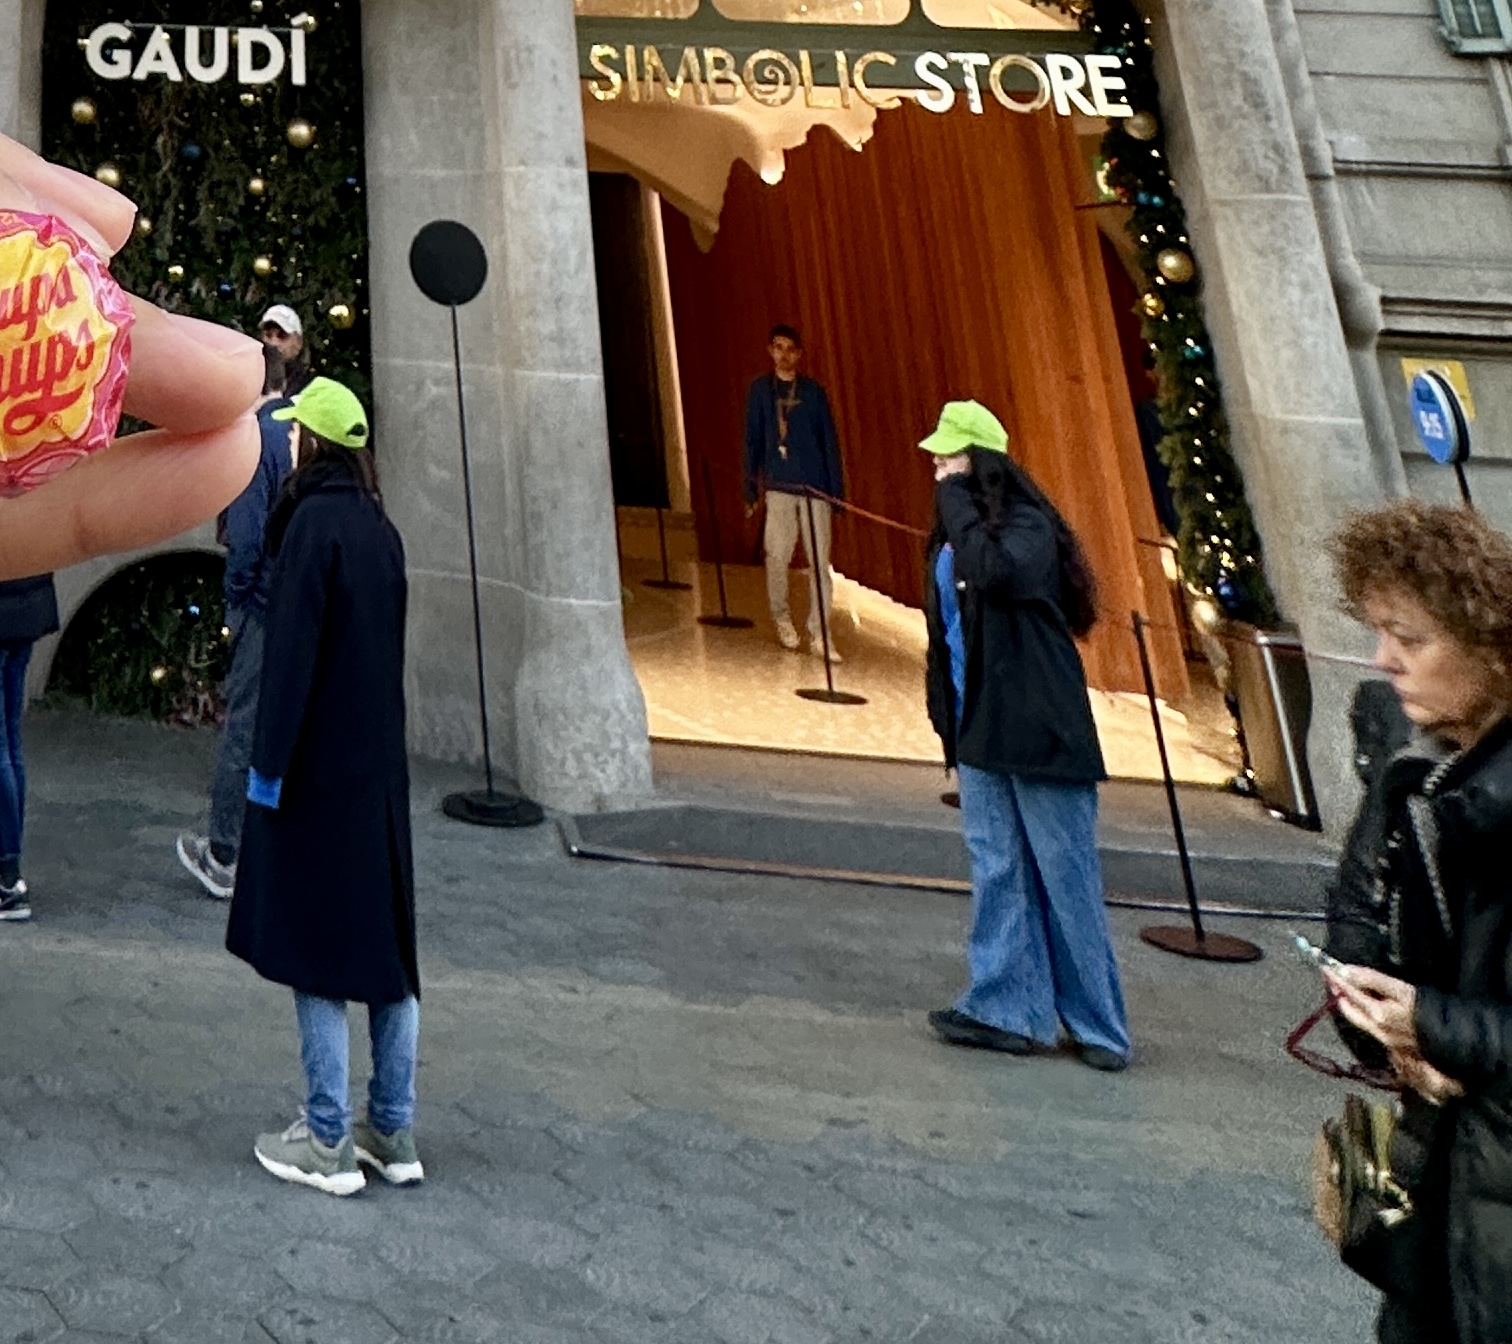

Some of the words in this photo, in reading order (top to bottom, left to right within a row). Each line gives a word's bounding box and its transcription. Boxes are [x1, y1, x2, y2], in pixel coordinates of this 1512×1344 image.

[85, 12, 307, 87] GAUDÍ
[588, 44, 903, 110] SIMBOLIC
[914, 51, 1134, 118] STORE
